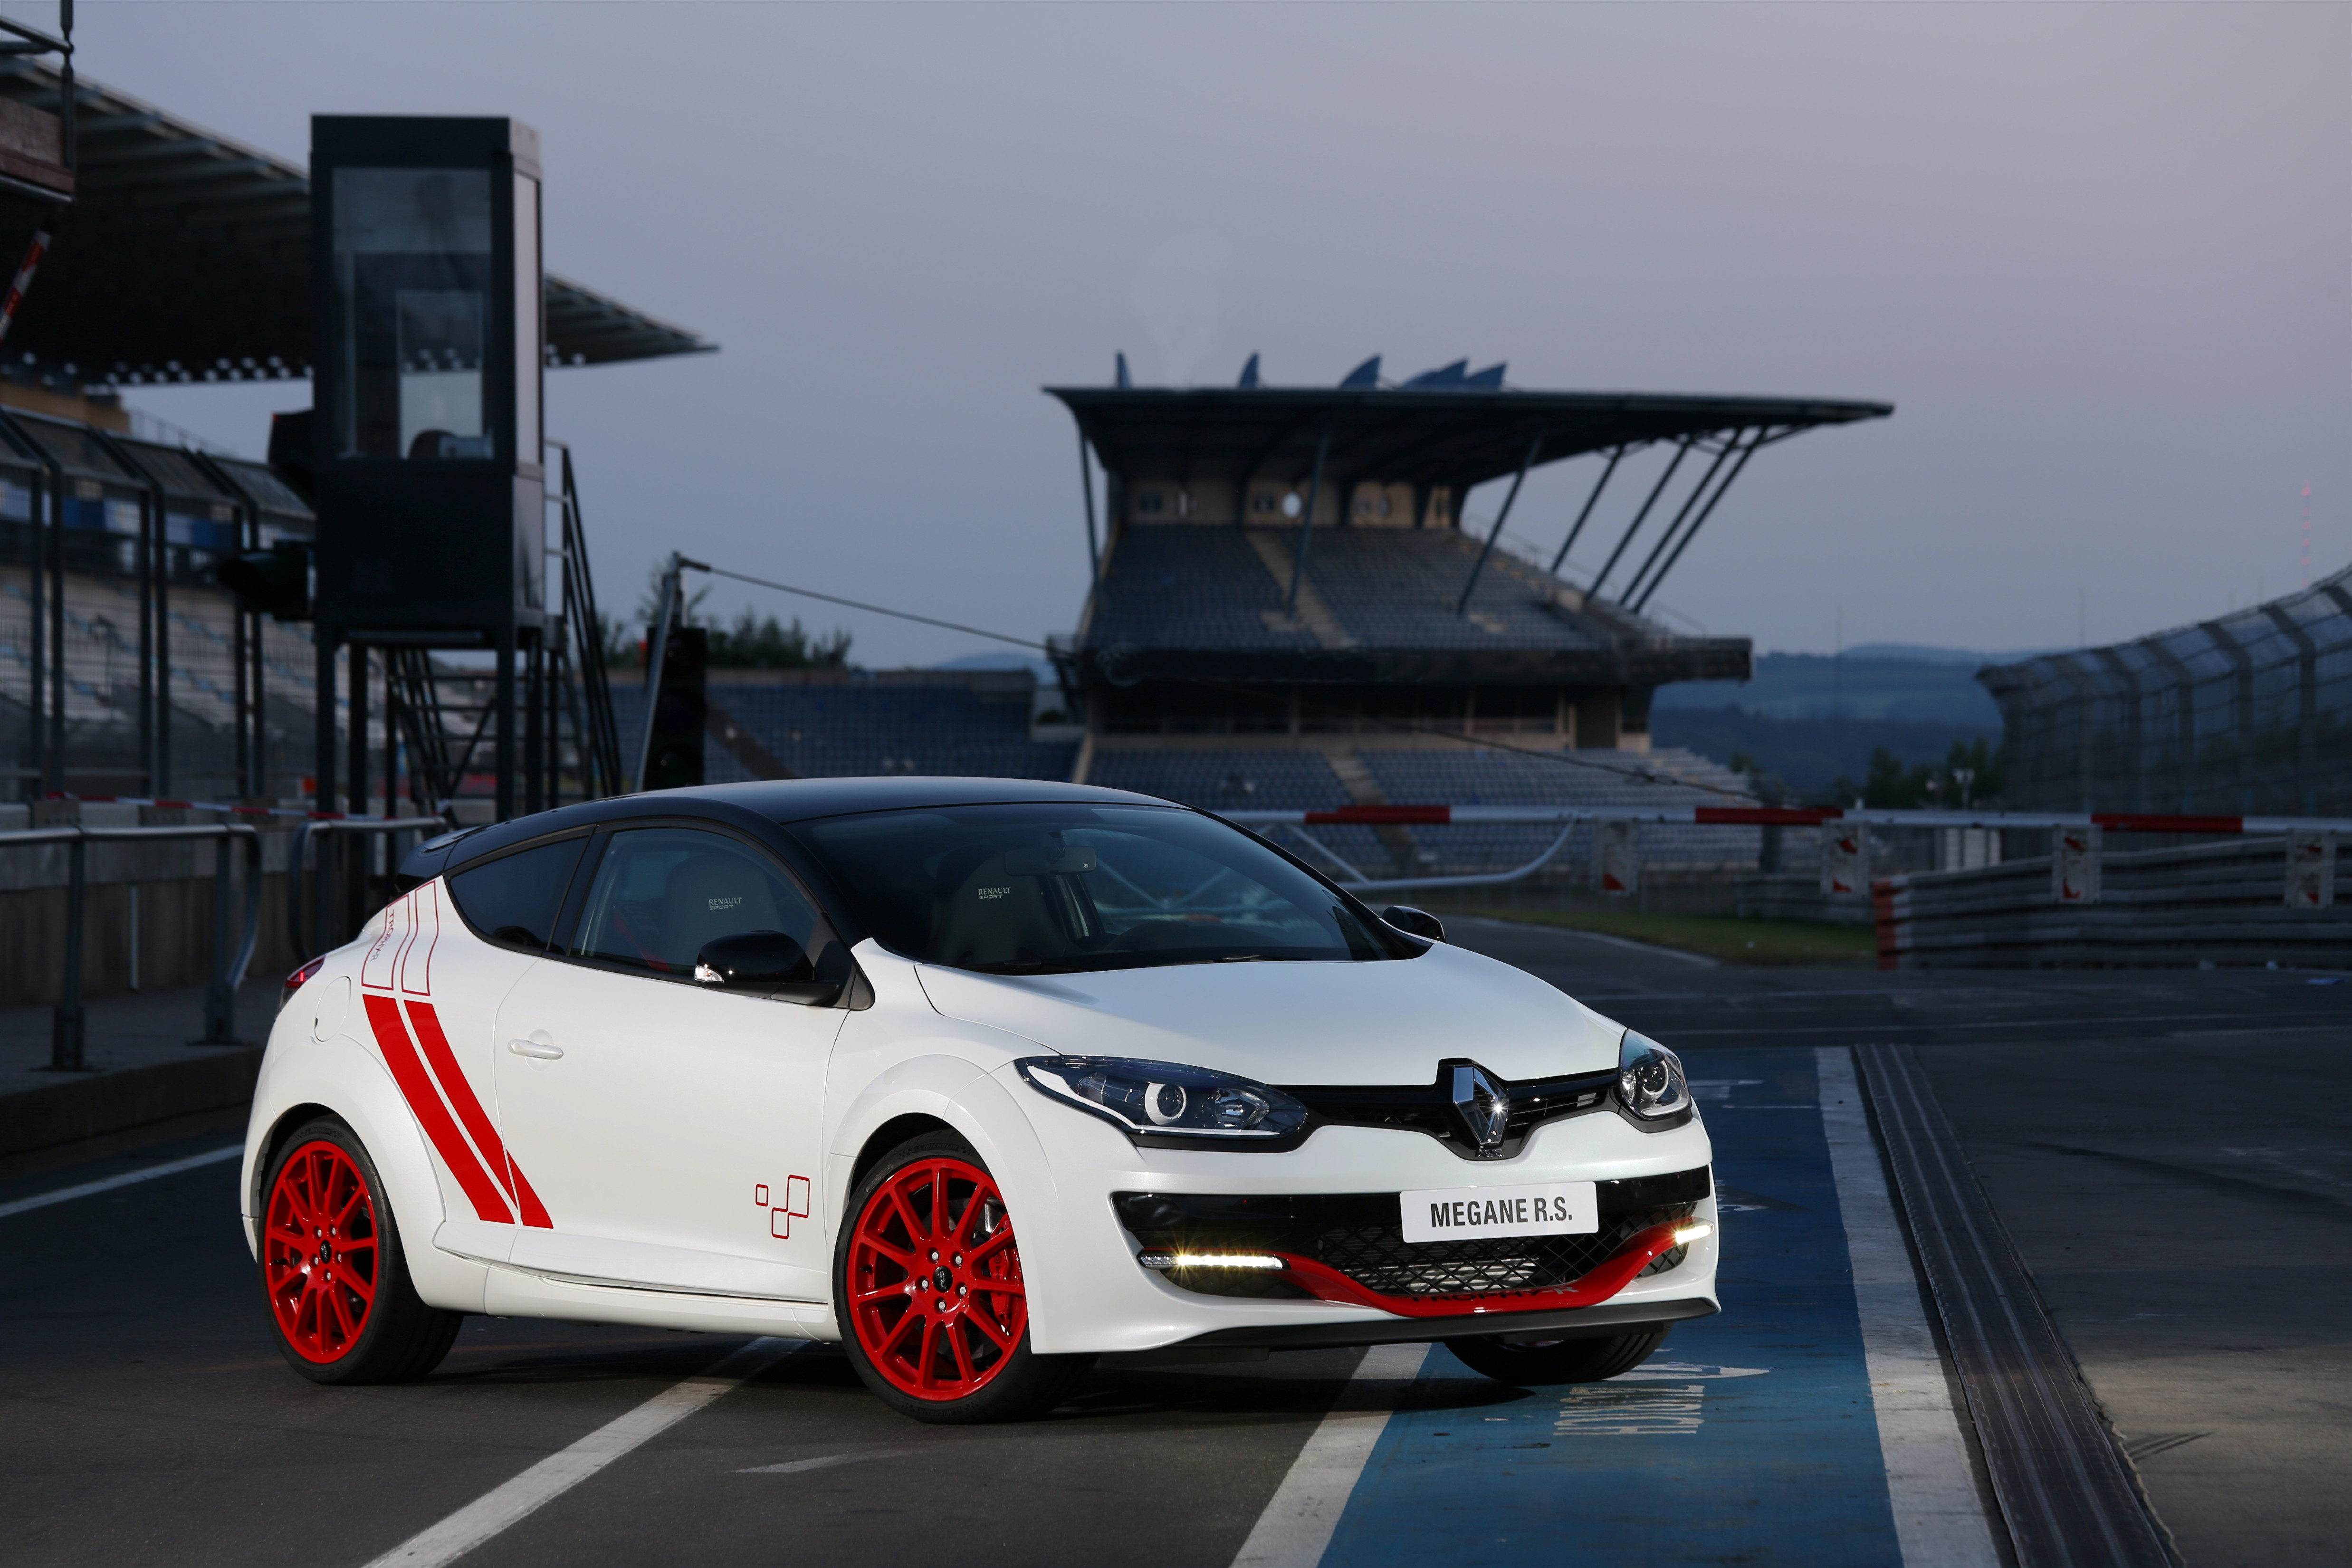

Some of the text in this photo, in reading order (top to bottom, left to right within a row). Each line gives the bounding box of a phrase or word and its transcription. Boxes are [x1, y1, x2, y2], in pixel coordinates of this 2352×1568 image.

[708, 897, 742, 906] RENAULT
[978, 887, 1011, 896] RENAULT
[370, 909, 394, 962] TROPHY-R
[1430, 1196, 1572, 1227] MEGANE R.S.
